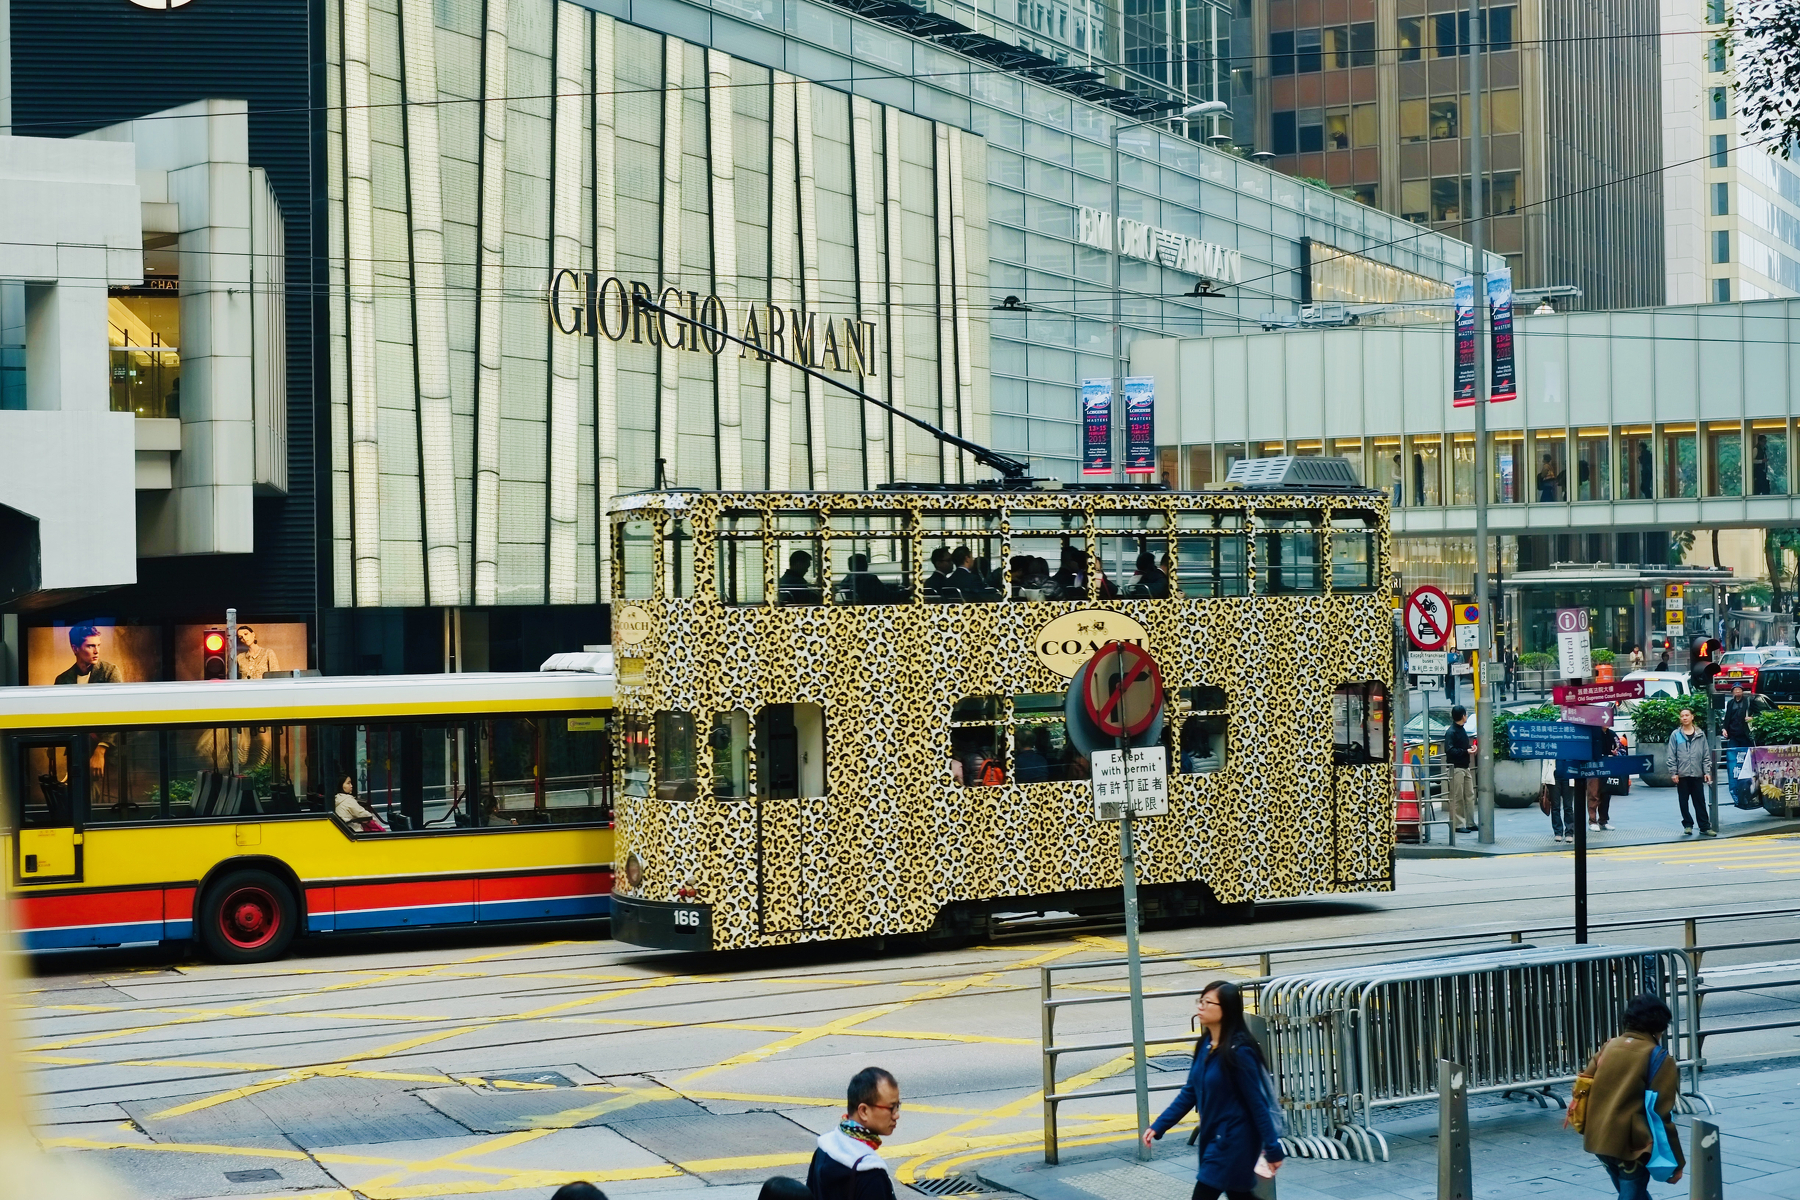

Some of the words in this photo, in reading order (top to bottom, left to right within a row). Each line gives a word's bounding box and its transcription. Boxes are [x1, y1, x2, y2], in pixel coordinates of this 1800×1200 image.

[1079, 205, 1157, 261] EMORIO
[1175, 234, 1242, 284] ARMANI
[551, 268, 728, 356] GIORGIO
[739, 301, 877, 377] ARMANI
[619, 621, 649, 631] COACH
[1041, 638, 1144, 655] COA
[1564, 637, 1575, 674] Central
[1535, 742, 1558, 750] 天星小輪
[1111, 752, 1144, 763] Exept
[1101, 766, 1121, 776] with
[673, 910, 700, 926] 166
